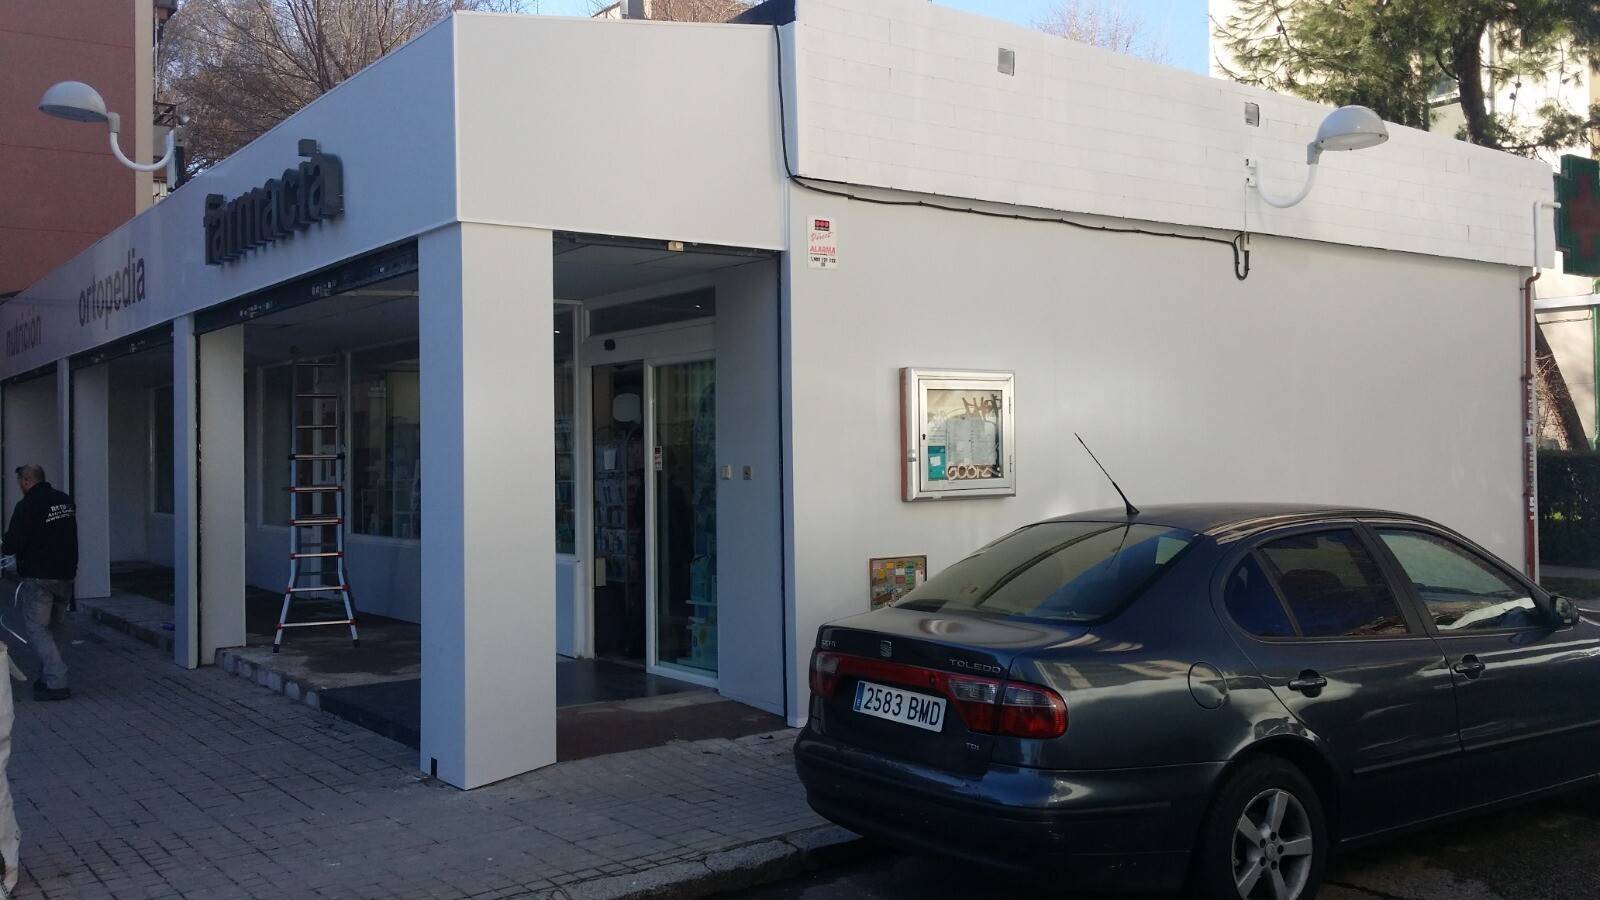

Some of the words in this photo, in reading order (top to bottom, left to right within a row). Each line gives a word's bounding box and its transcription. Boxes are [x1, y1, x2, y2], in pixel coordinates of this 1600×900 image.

[203, 138, 345, 266] farmacia
[79, 247, 146, 330] ortopedia
[948, 658, 1001, 674] TOLEDO
[863, 687, 903, 716] 2583
[907, 696, 941, 725] BMD
